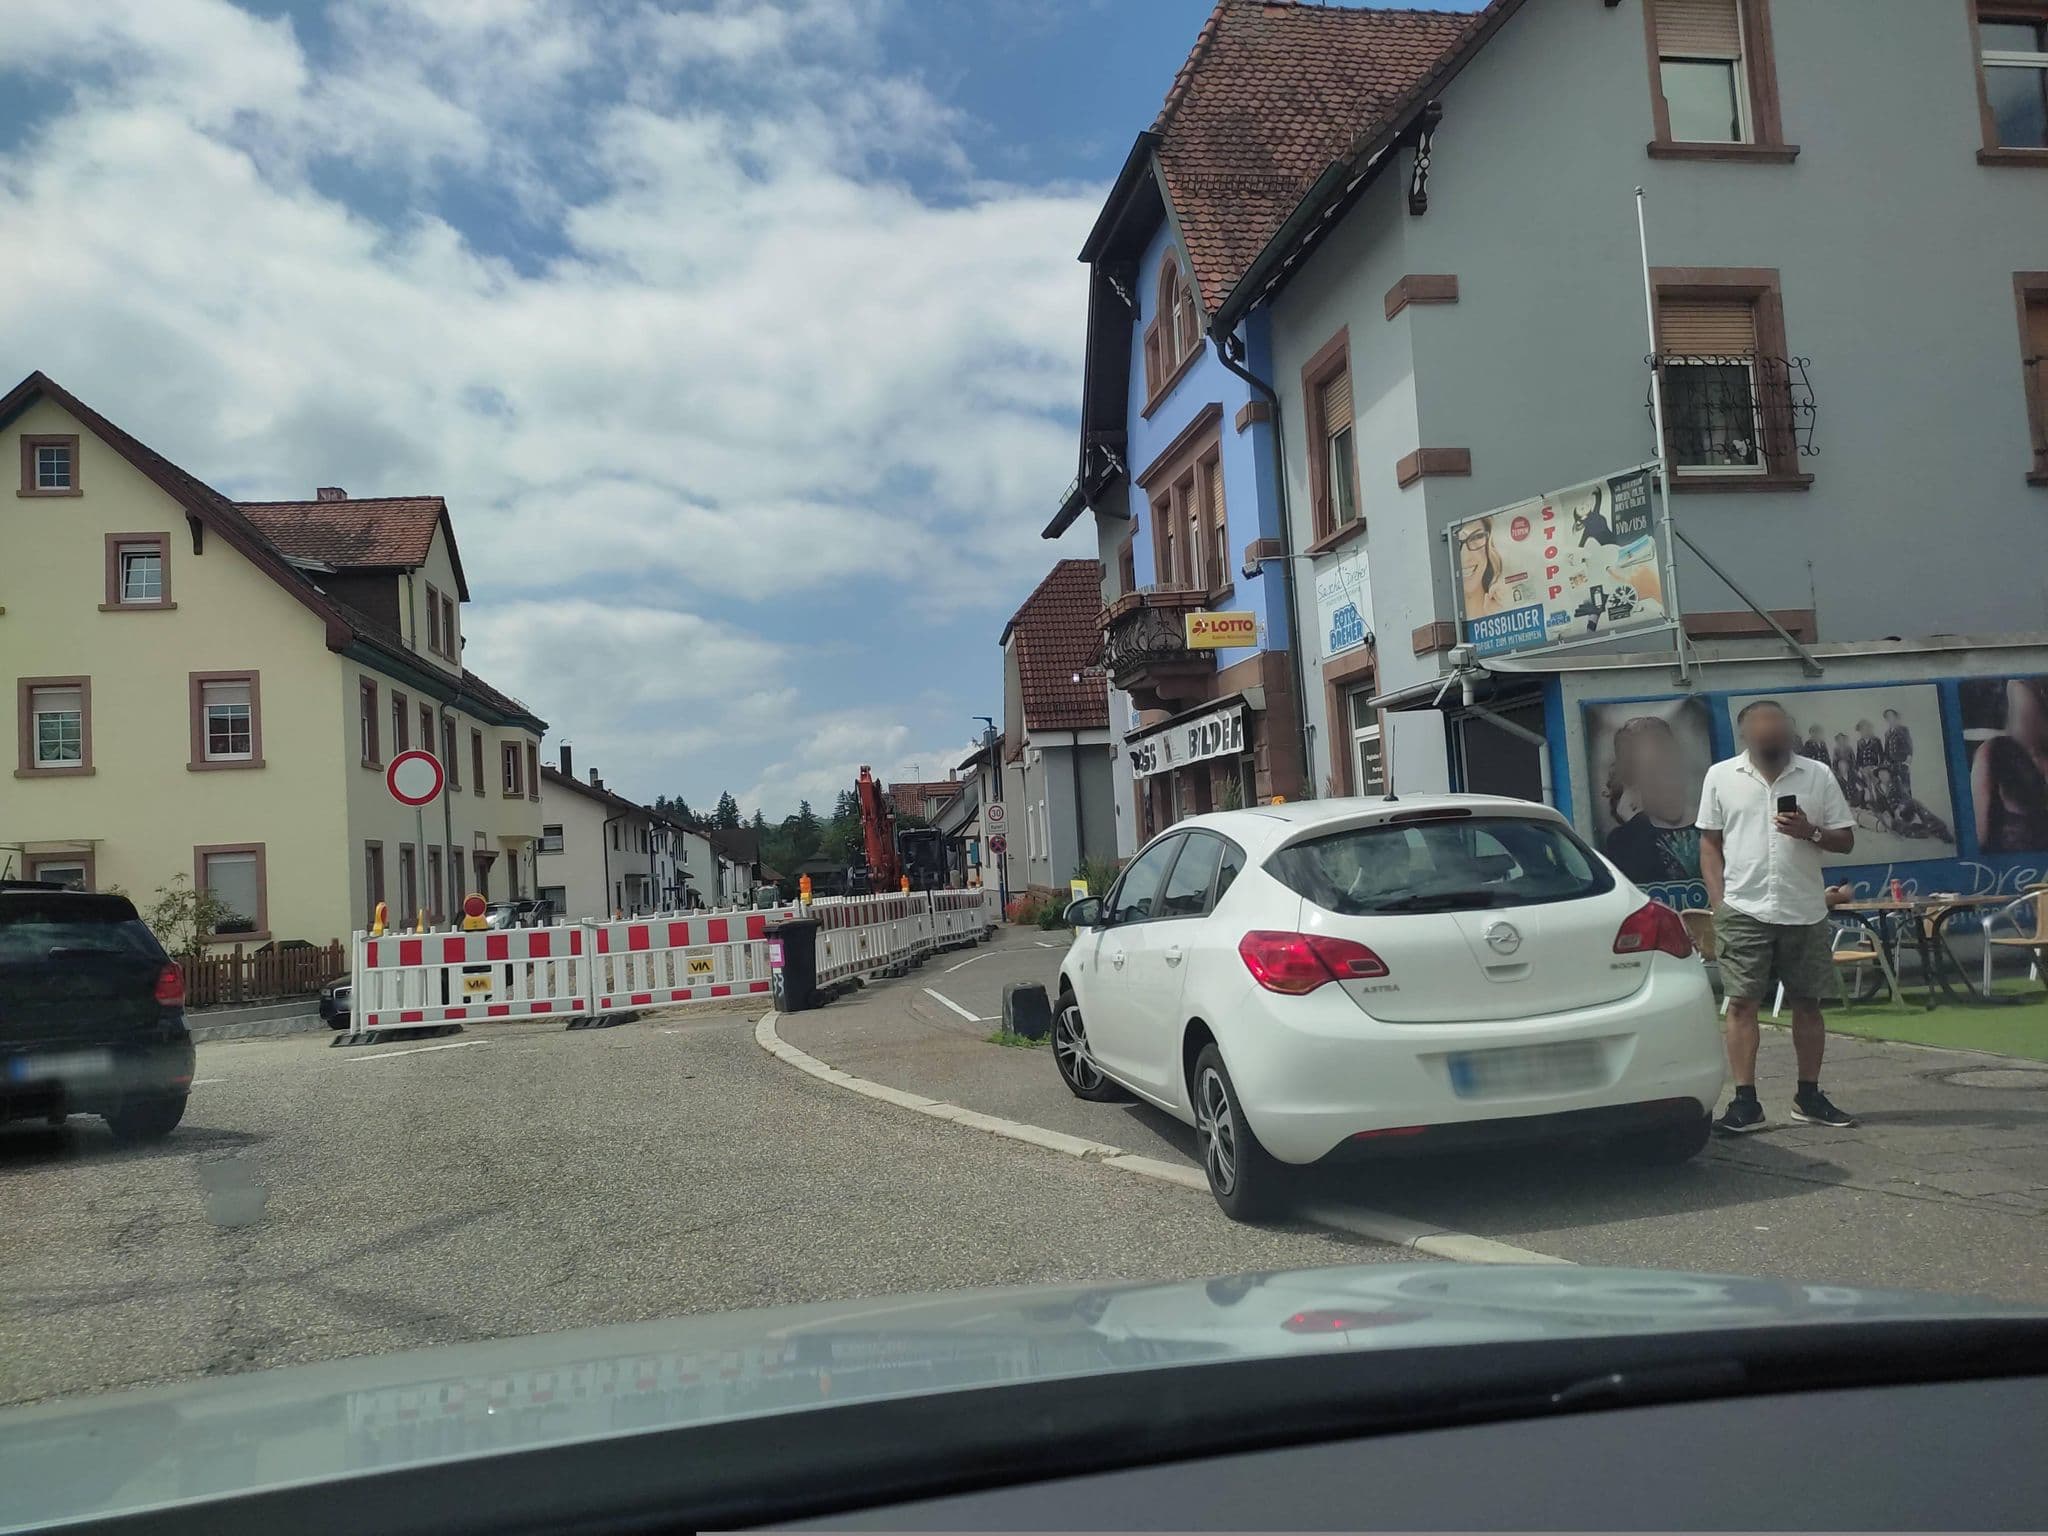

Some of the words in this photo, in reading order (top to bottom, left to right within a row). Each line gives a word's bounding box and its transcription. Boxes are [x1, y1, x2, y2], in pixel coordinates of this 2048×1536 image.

[1541, 506, 1562, 600] STOPP
[1211, 620, 1254, 632] LOTTO
[1334, 606, 1356, 630] FOTO
[1473, 608, 1541, 640] PASSBILDER
[1330, 620, 1363, 652] DREHER
[1188, 715, 1242, 759] BILDER
[991, 809, 1001, 818] 30
[1959, 860, 2048, 898] Dre
[1638, 882, 1711, 912] OTO
